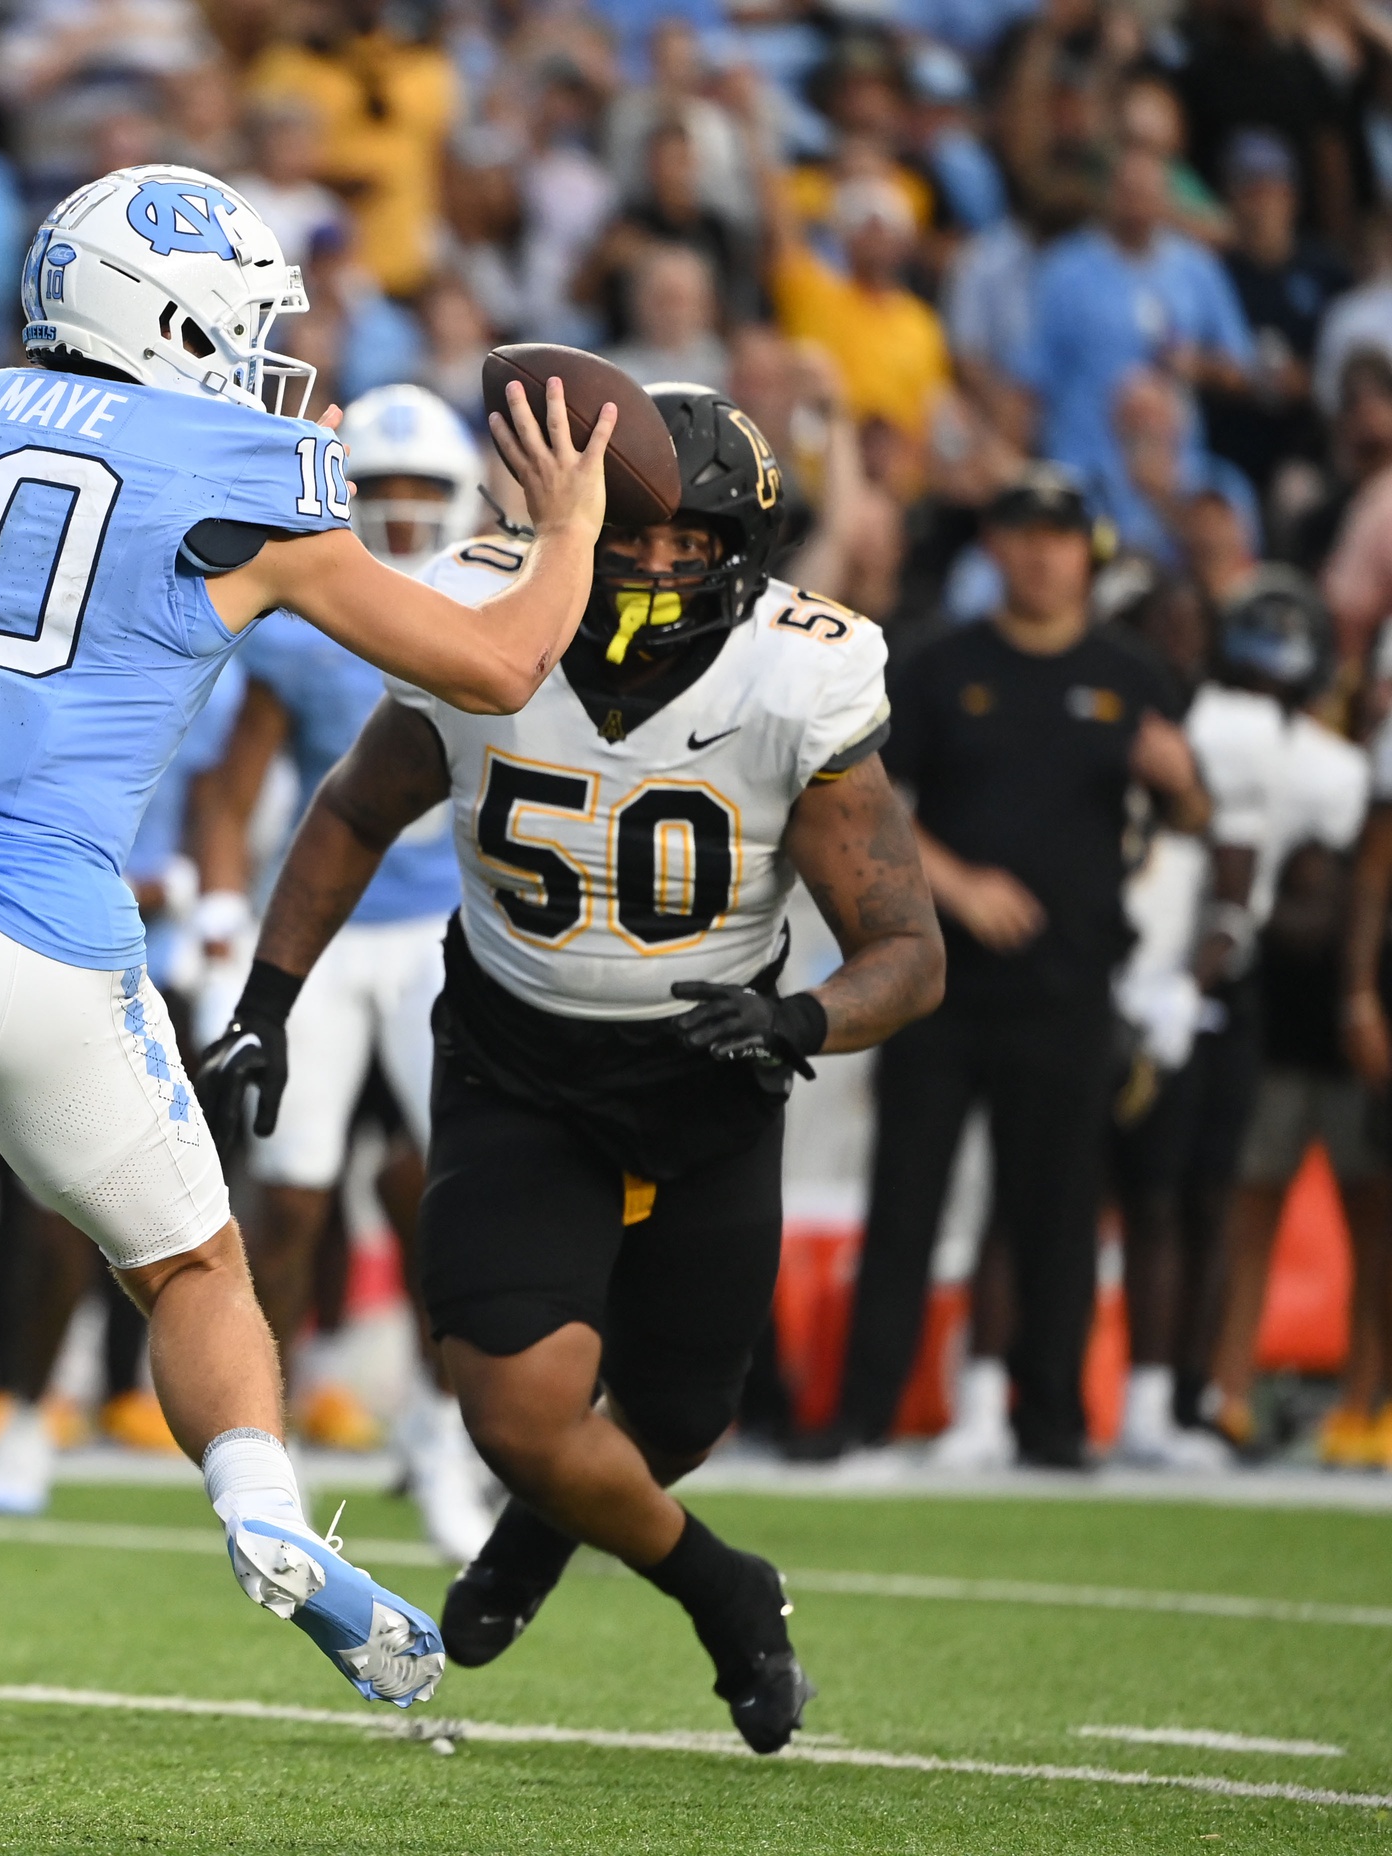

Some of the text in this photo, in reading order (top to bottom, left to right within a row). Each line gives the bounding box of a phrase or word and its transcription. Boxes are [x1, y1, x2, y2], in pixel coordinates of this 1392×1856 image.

[46, 269, 65, 300] 10
[27, 325, 57, 341] HEELS
[295, 436, 351, 522] 10
[473, 744, 744, 957] 50
